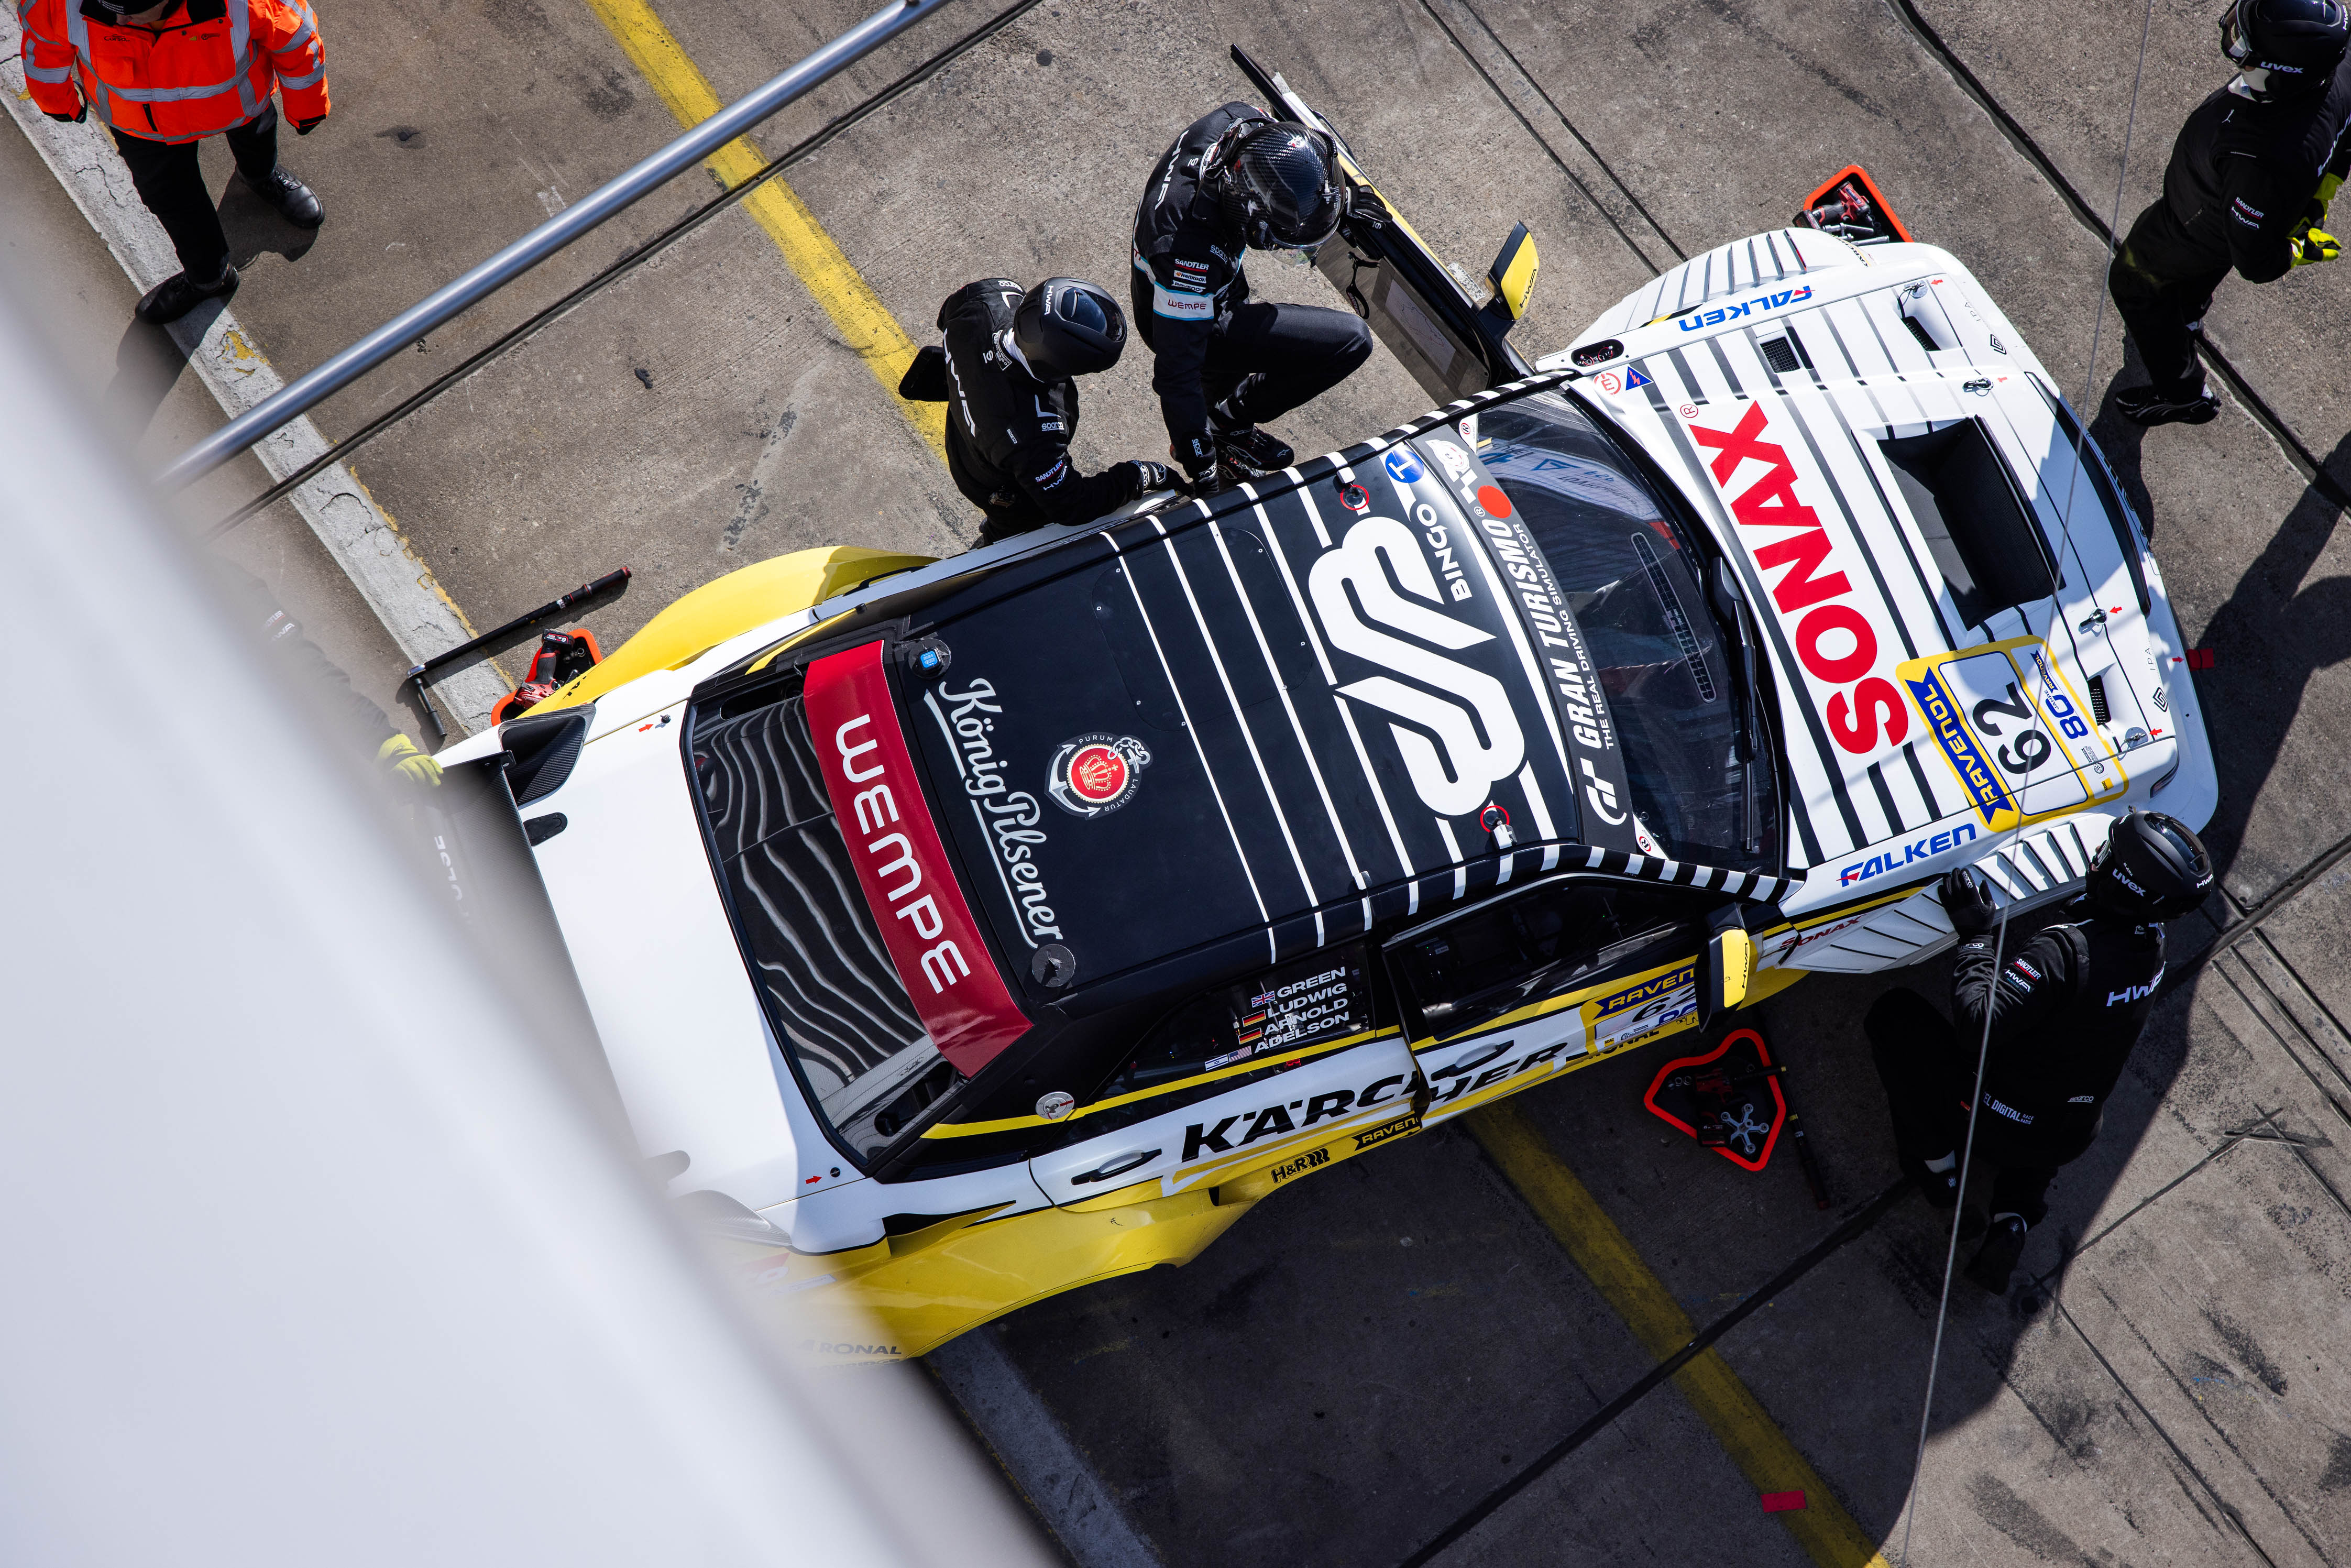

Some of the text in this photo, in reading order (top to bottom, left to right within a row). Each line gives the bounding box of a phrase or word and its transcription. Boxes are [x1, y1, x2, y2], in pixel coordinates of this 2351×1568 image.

[2260, 61, 2304, 73] uvex
[1155, 129, 1189, 210] HWA
[2232, 206, 2259, 229] HWA
[2236, 197, 2264, 218] SANDTLER
[1175, 258, 1209, 270] SANDTLER
[1210, 244, 1228, 264] sparco
[1045, 285, 1054, 315] HWA
[1168, 299, 1207, 310] WEMPE
[1520, 268, 1537, 309] HWA
[1678, 286, 1816, 332] FALKEN
[943, 328, 976, 437] HWA
[1006, 429, 1018, 444] sparco
[1041, 421, 1065, 431] sparco
[1192, 438, 1203, 457] spar
[1035, 459, 1063, 483] SANDTLER
[1415, 503, 1473, 602] BINGO
[1481, 519, 1569, 648] TURISMO
[1687, 400, 1909, 754] SONAX
[1512, 523, 1614, 750] THE REAL DRIVING SIMULATOR
[2035, 653, 2056, 690] RAVENOL
[2145, 647, 2156, 671] IPA
[1550, 657, 1602, 749] GRAN
[2044, 689, 2060, 710] JAHRE
[1973, 682, 2051, 774] 62
[2045, 694, 2089, 740] 80
[1079, 734, 1114, 744] PURUM
[1924, 682, 2001, 807] RAVENOL
[938, 677, 1063, 941] König Pilsener
[1104, 778, 1138, 812] LAUDATUR
[836, 714, 971, 995] WEMPE
[1836, 823, 1976, 887] FALKEN
[1962, 871, 1973, 889] sparco
[2112, 868, 2146, 897] uvex
[2196, 873, 2214, 889] HWA
[1779, 914, 1866, 949] SONAX
[1277, 966, 1346, 997] GREEN
[2005, 969, 2031, 992] HWA
[2016, 958, 2041, 980] SANDTLER
[2106, 961, 2166, 1006] HWA
[1267, 983, 1347, 1018] LUDWIG
[1608, 968, 1695, 1010] RAVEN
[1254, 1011, 1350, 1054] ADELSON
[1264, 998, 1348, 1036] ARNOLD
[1991, 1099, 2020, 1122] DIGITAL
[1361, 1116, 1419, 1144] RAVEN
[1272, 1155, 1311, 1183] H&R
